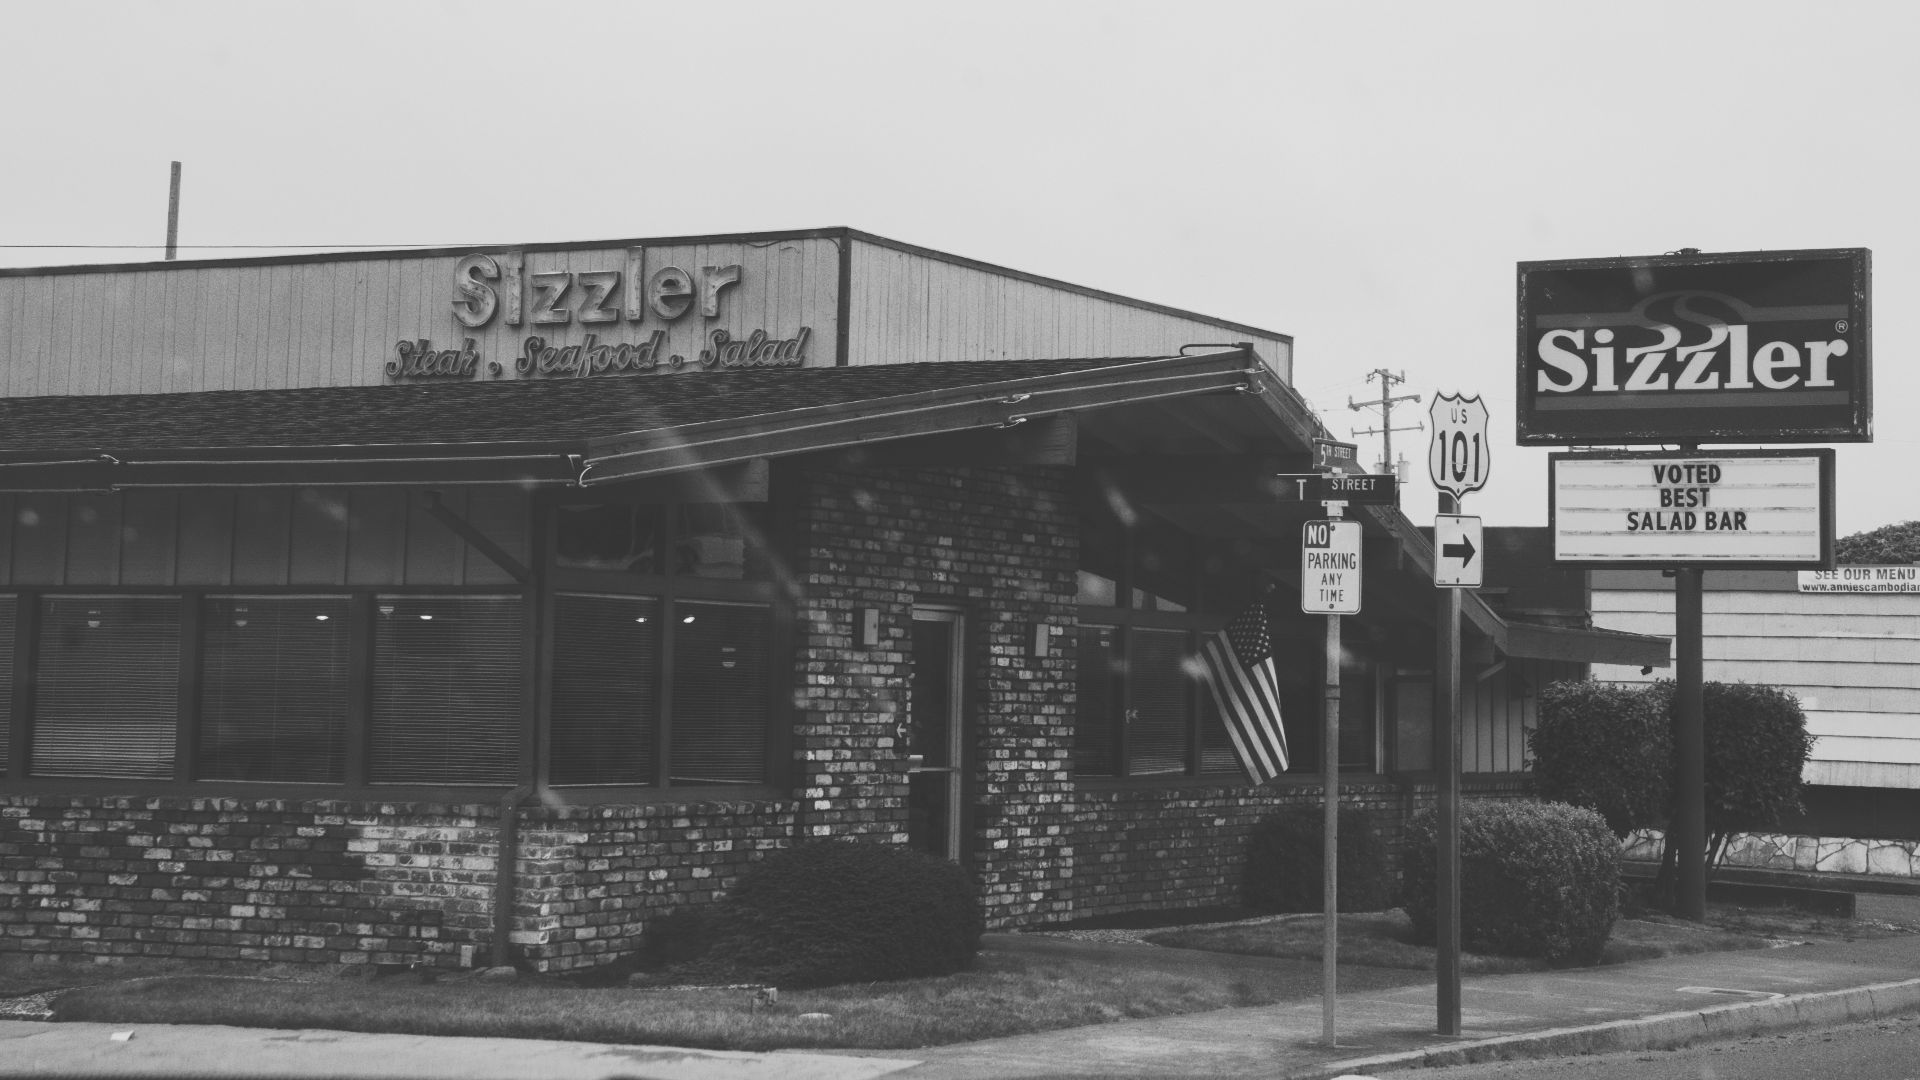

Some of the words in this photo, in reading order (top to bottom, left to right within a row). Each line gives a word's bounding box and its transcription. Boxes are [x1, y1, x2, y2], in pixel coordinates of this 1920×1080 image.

[453, 245, 742, 328] Sizzler
[386, 337, 480, 378] Steak
[515, 329, 666, 378] Seafood
[700, 326, 812, 368] Salad
[1537, 324, 1849, 393] Sizzler
[1439, 430, 1480, 483] 101
[1653, 464, 1722, 484] VOTED
[1296, 479, 1307, 501] T
[1331, 478, 1376, 491] STREET
[1660, 487, 1710, 508] BEST
[1627, 511, 1697, 531] SALAD
[1705, 510, 1747, 531] BAR
[1307, 524, 1328, 545] NO
[1308, 552, 1357, 570] PARKING
[1321, 572, 1343, 586] ANY
[1815, 569, 1839, 581] SEE
[1843, 568, 1871, 581] OUR
[1876, 567, 1916, 580] MENU
[1320, 589, 1344, 603] TIME
